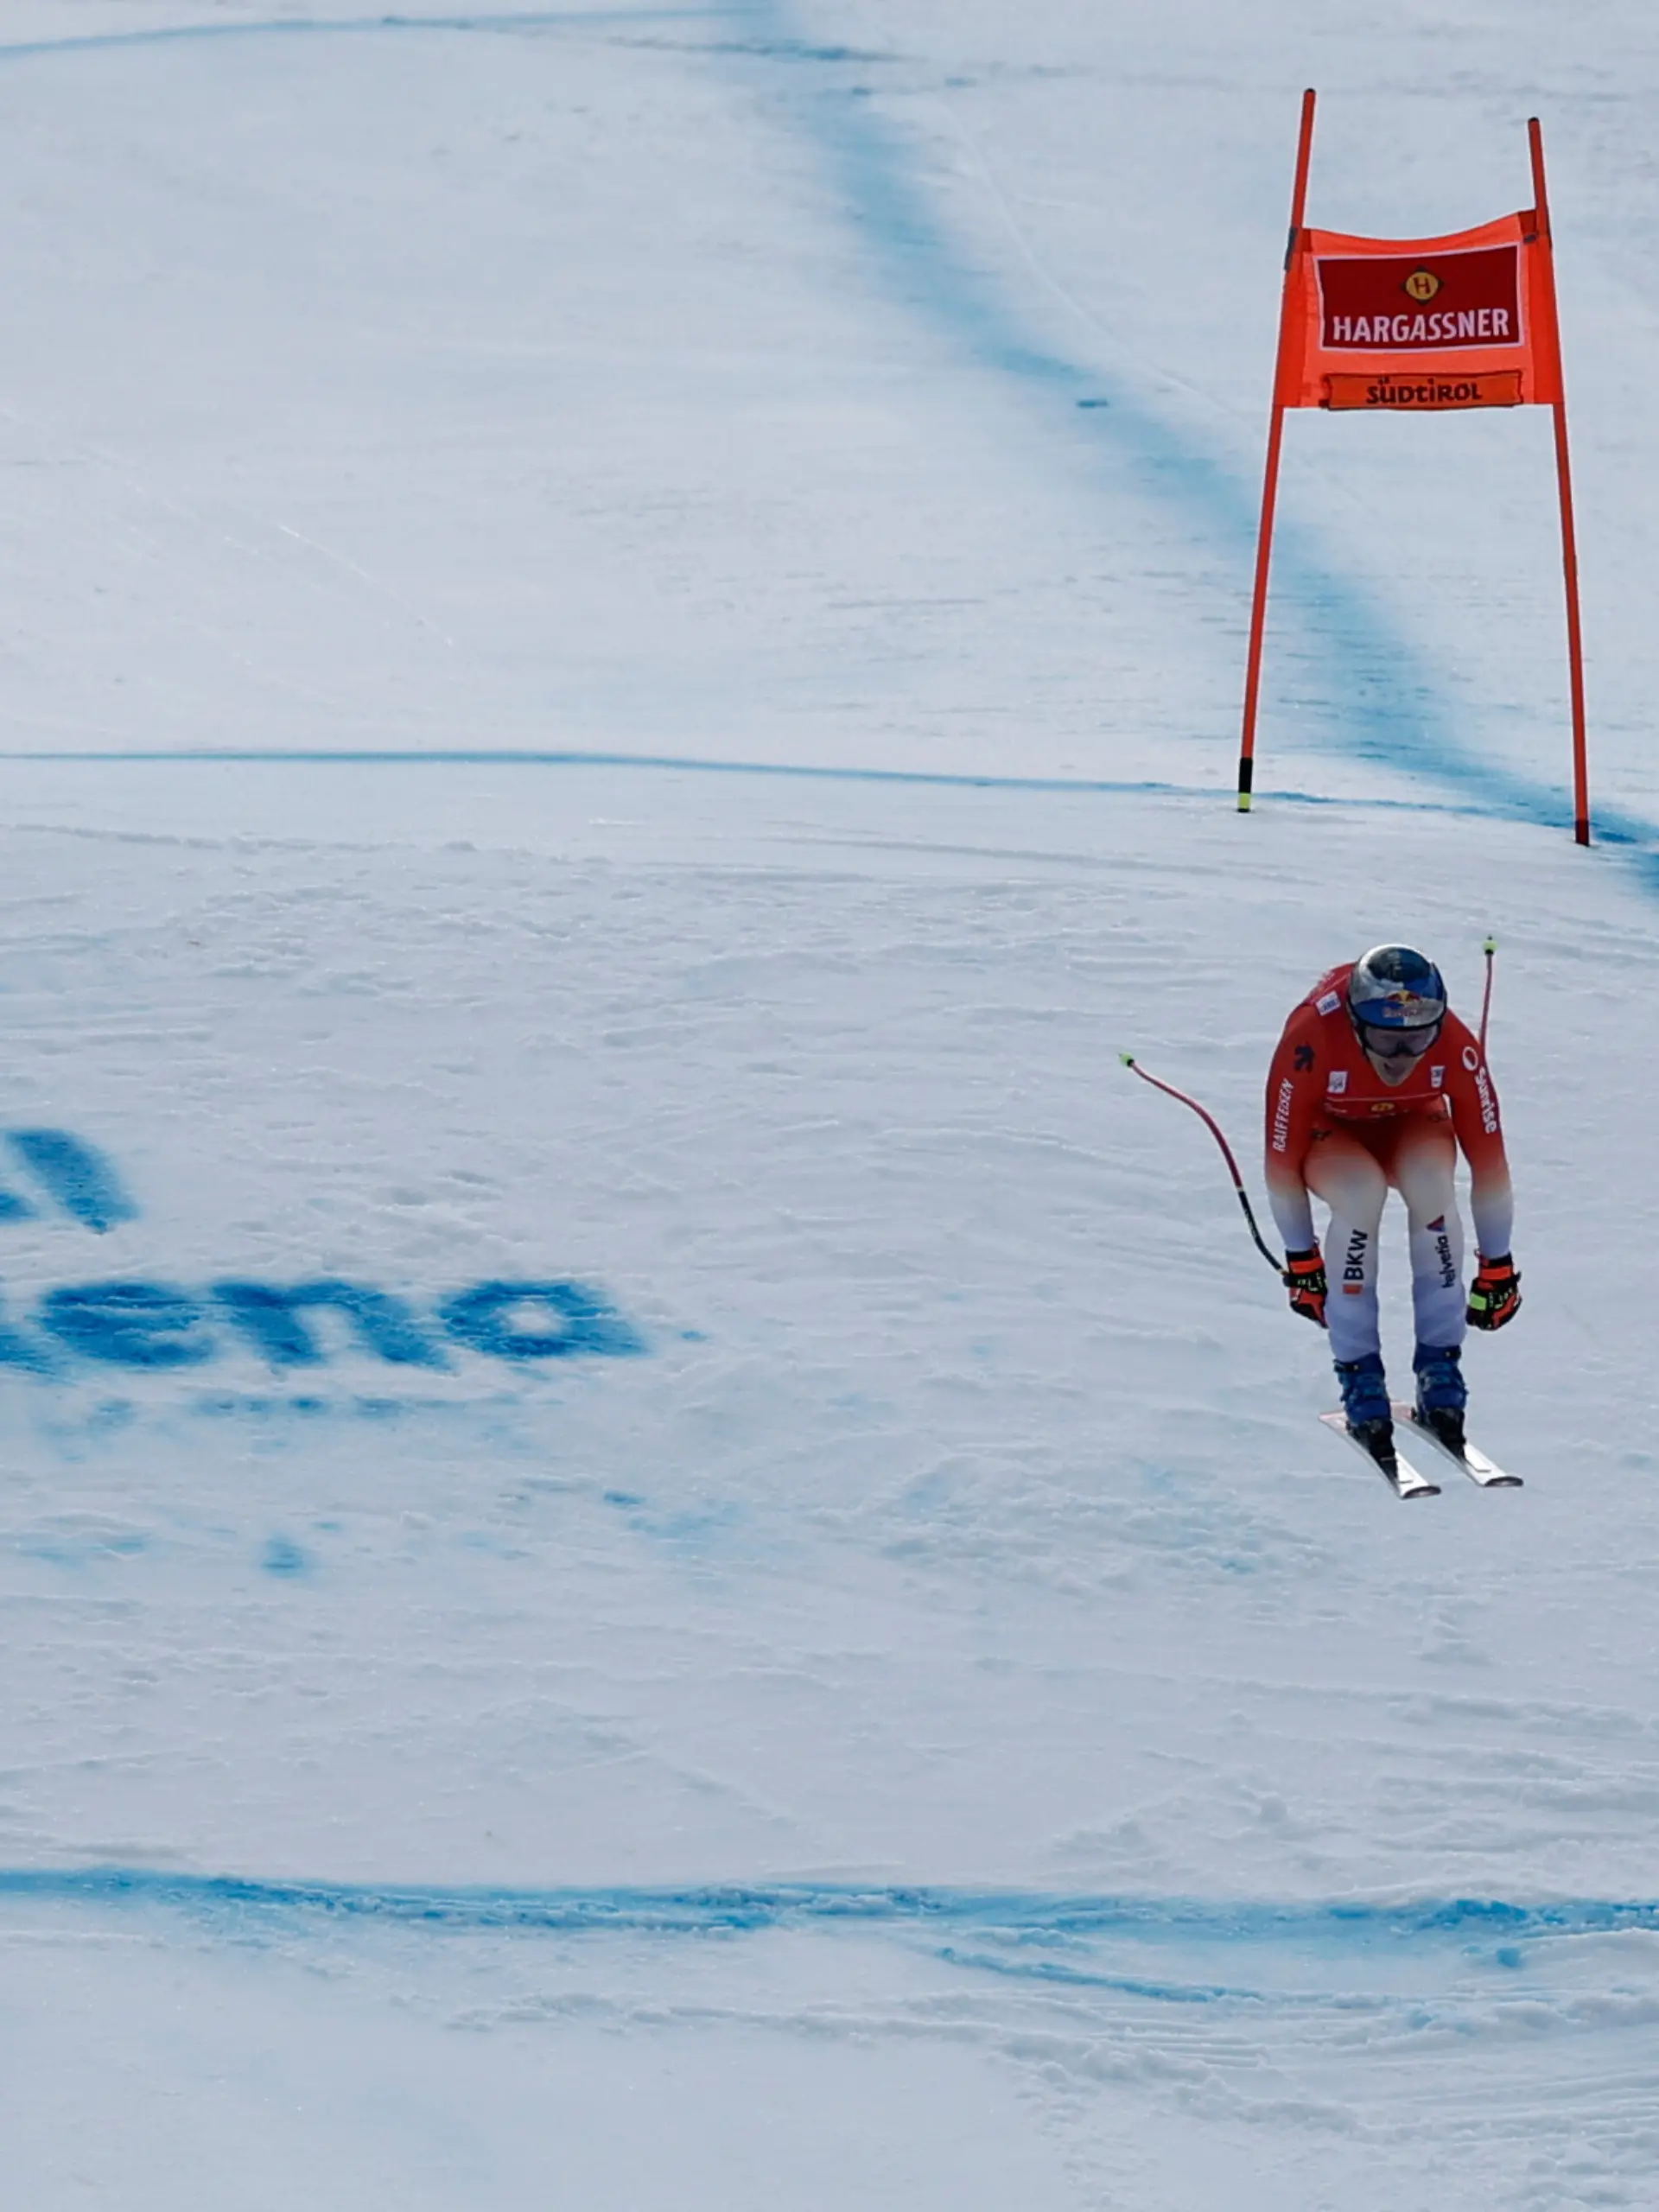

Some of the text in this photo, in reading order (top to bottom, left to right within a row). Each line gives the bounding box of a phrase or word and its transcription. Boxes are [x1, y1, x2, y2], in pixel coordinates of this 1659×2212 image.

[1332, 308, 1510, 342] HARGASSNER
[1475, 1066, 1497, 1134] Sunrise
[1343, 1228, 1369, 1281] BKW
[1435, 1235, 1456, 1288] helvetia
